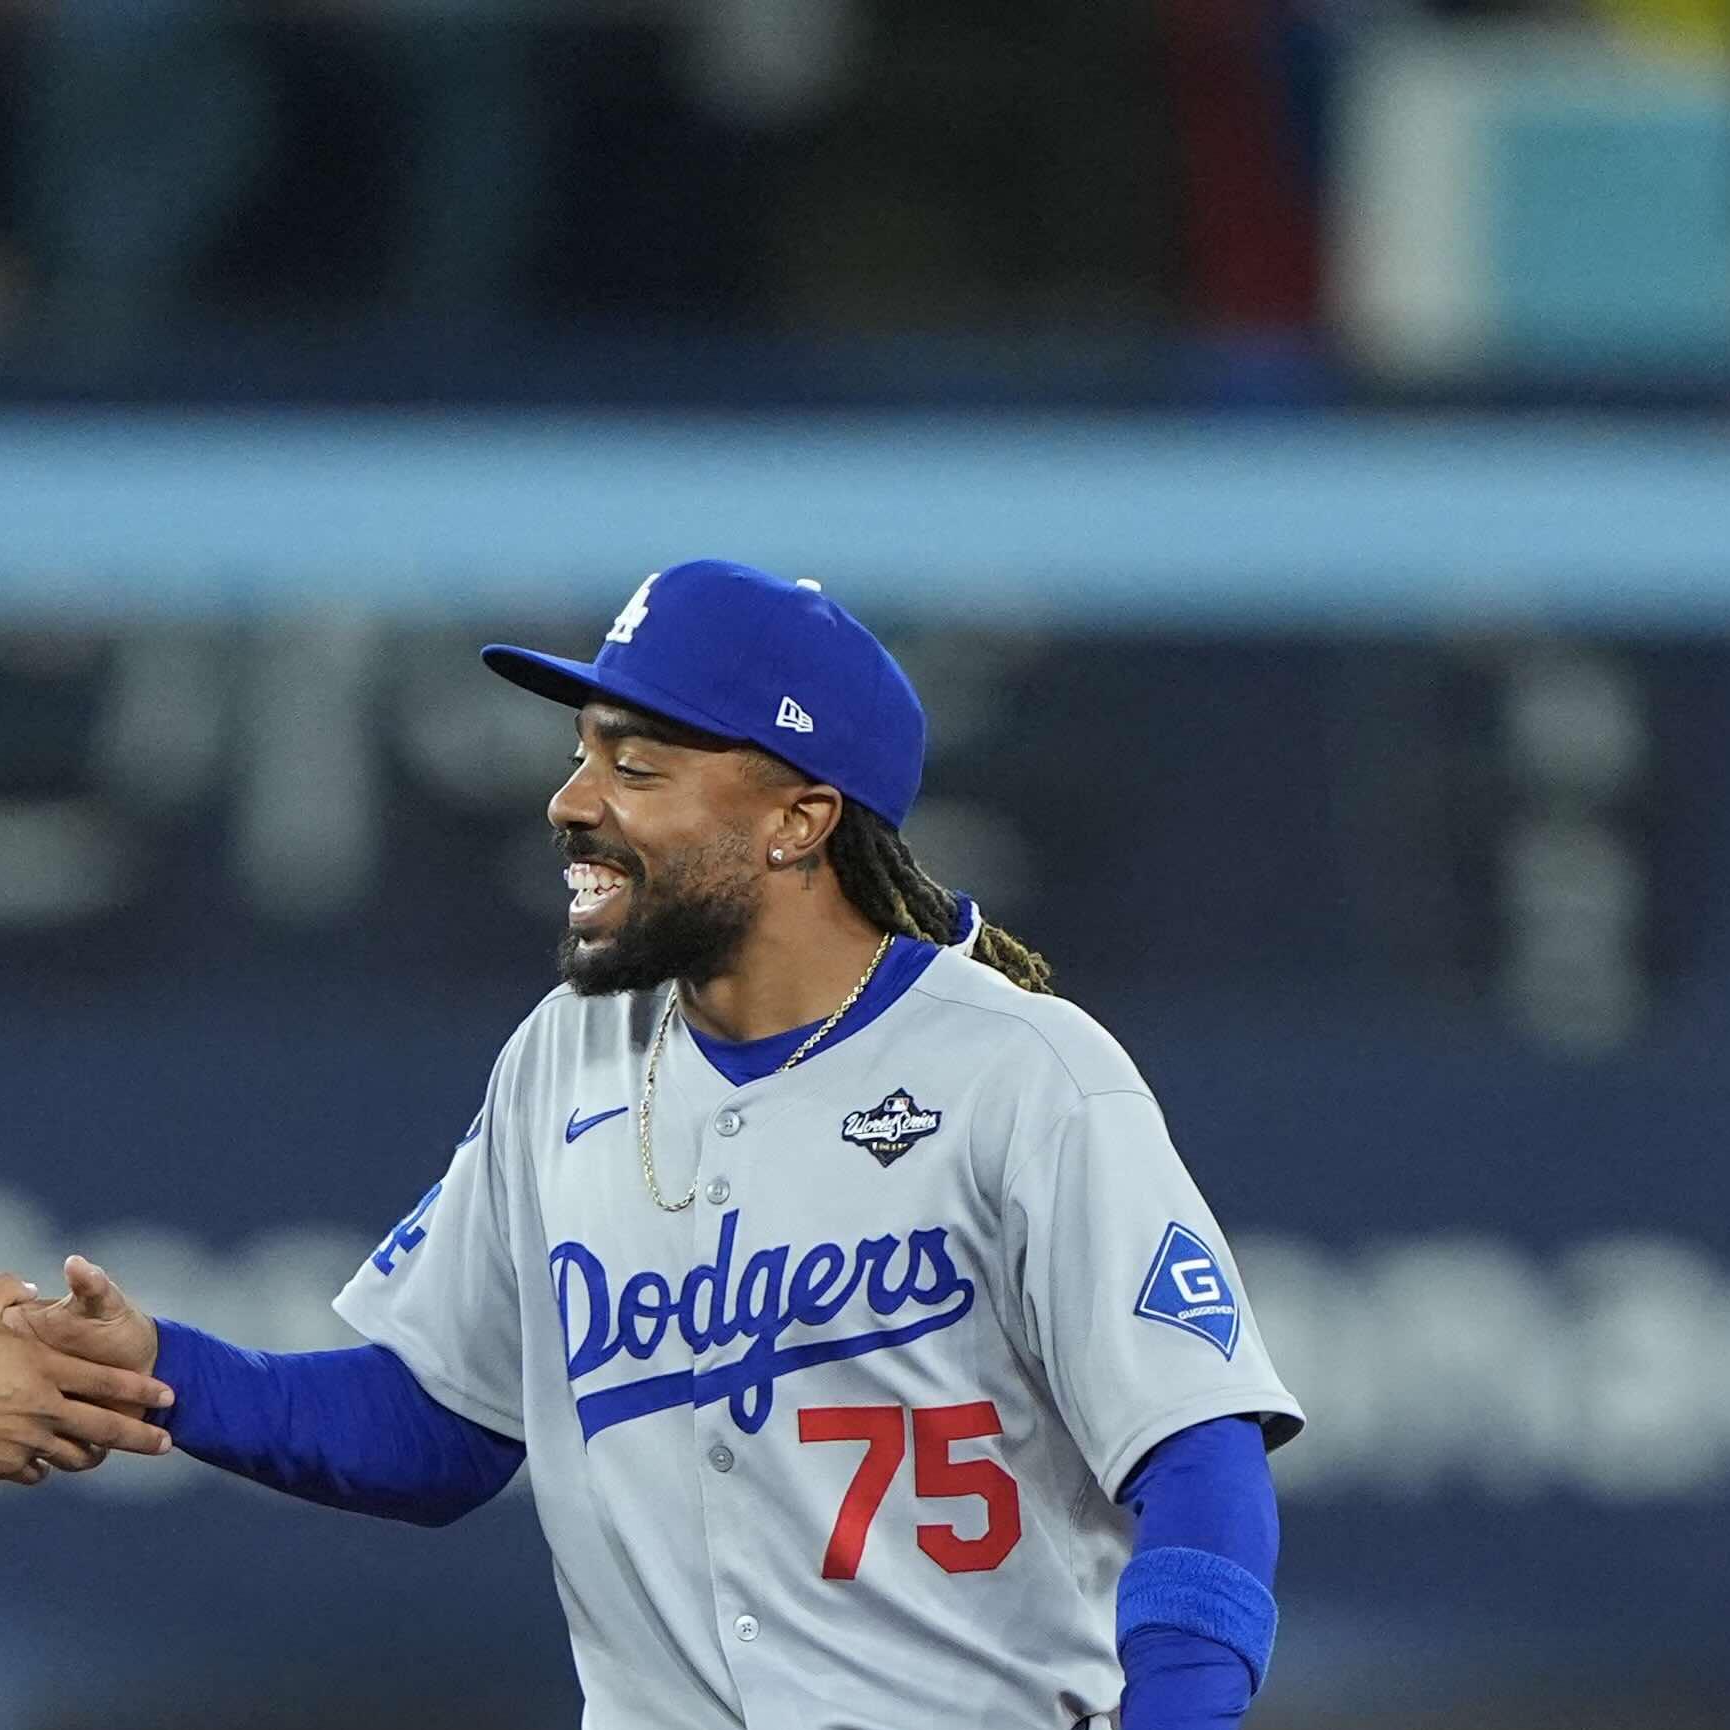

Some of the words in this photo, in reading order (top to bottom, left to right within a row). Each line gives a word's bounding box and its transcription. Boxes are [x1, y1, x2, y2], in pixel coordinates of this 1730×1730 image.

[550, 1208, 975, 1434] Dodgers
[1171, 1259, 1220, 1303] G
[798, 1400, 1022, 1580] 75
